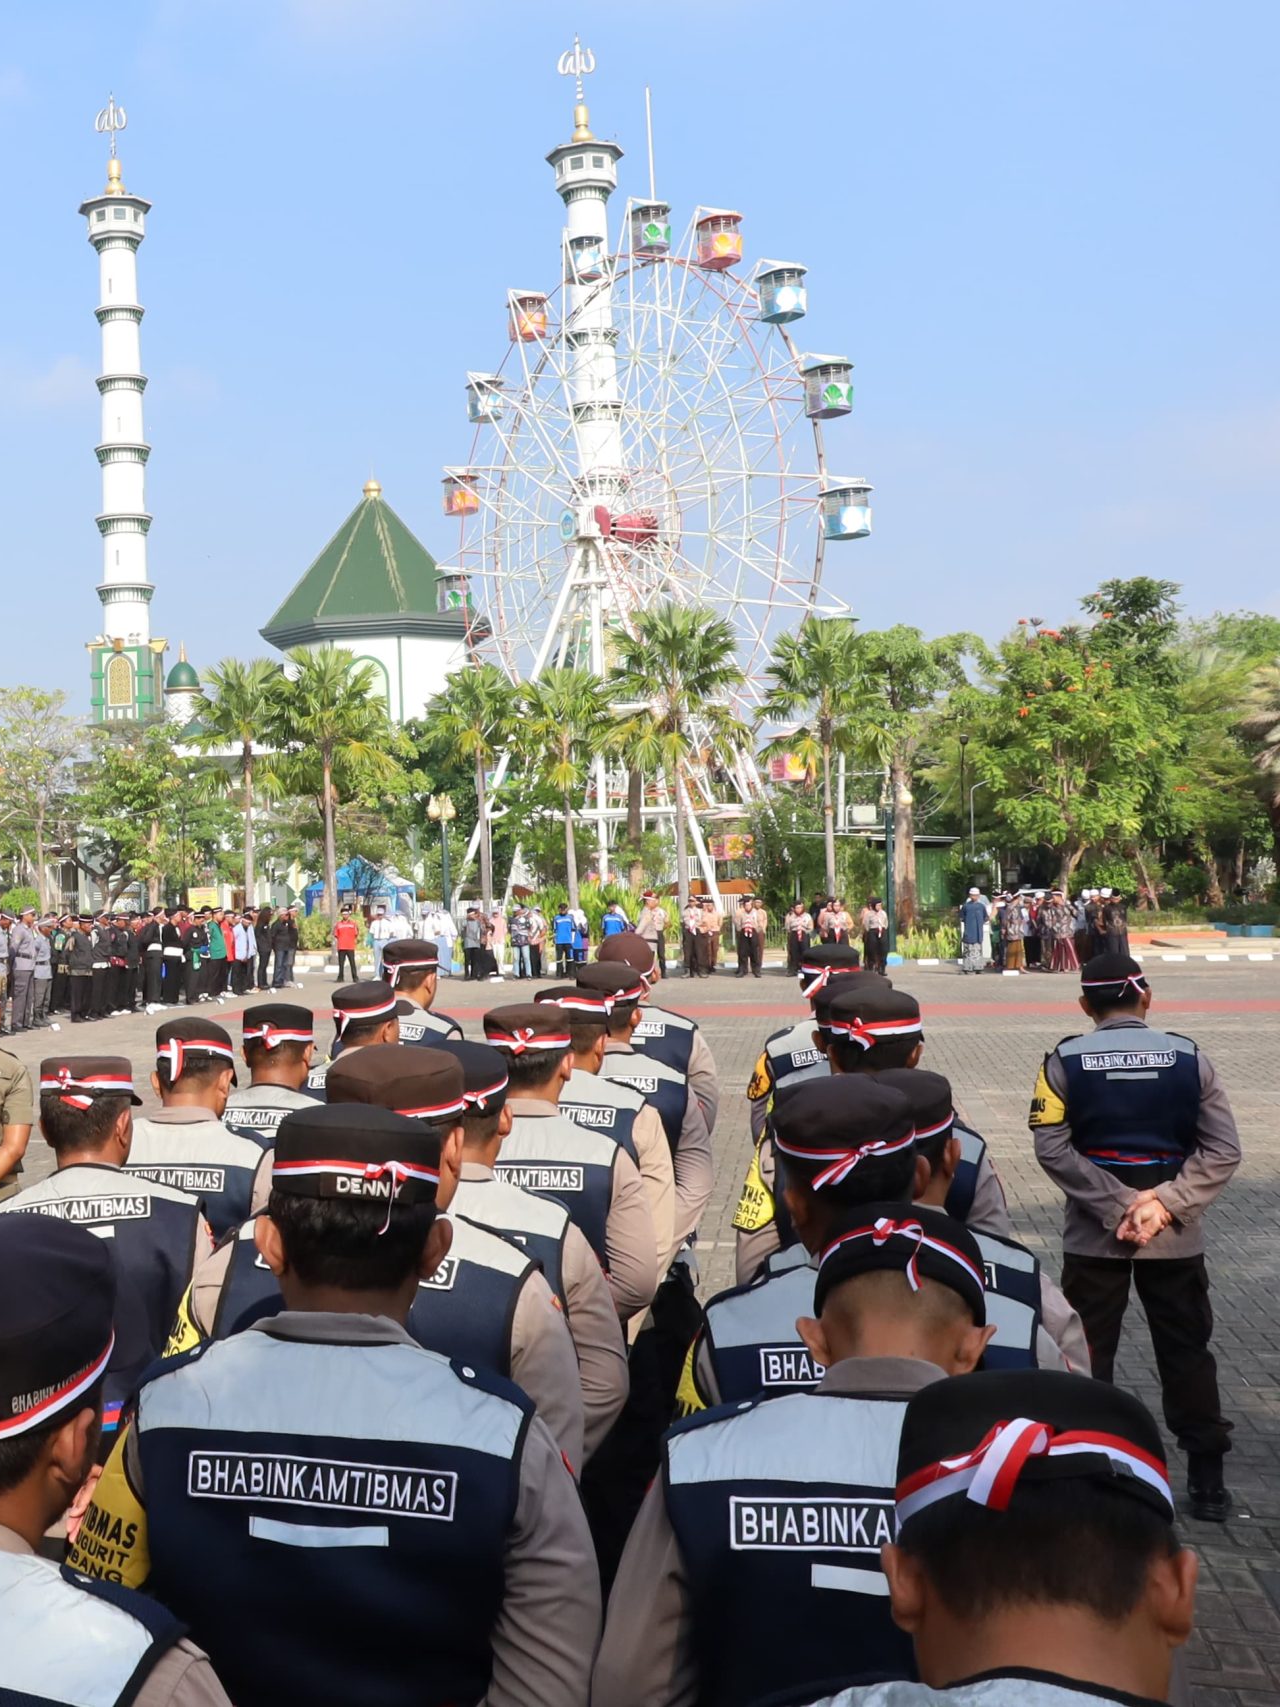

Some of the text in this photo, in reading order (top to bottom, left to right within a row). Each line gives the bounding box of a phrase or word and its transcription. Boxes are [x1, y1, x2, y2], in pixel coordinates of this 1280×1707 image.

[1085, 1052, 1174, 1068] BHABINKAMTIBMAS
[336, 1176, 403, 1198] DENNY
[197, 1458, 446, 1513] BHABINKAMTIBMAS
[741, 1506, 902, 1546] BHABINKA
